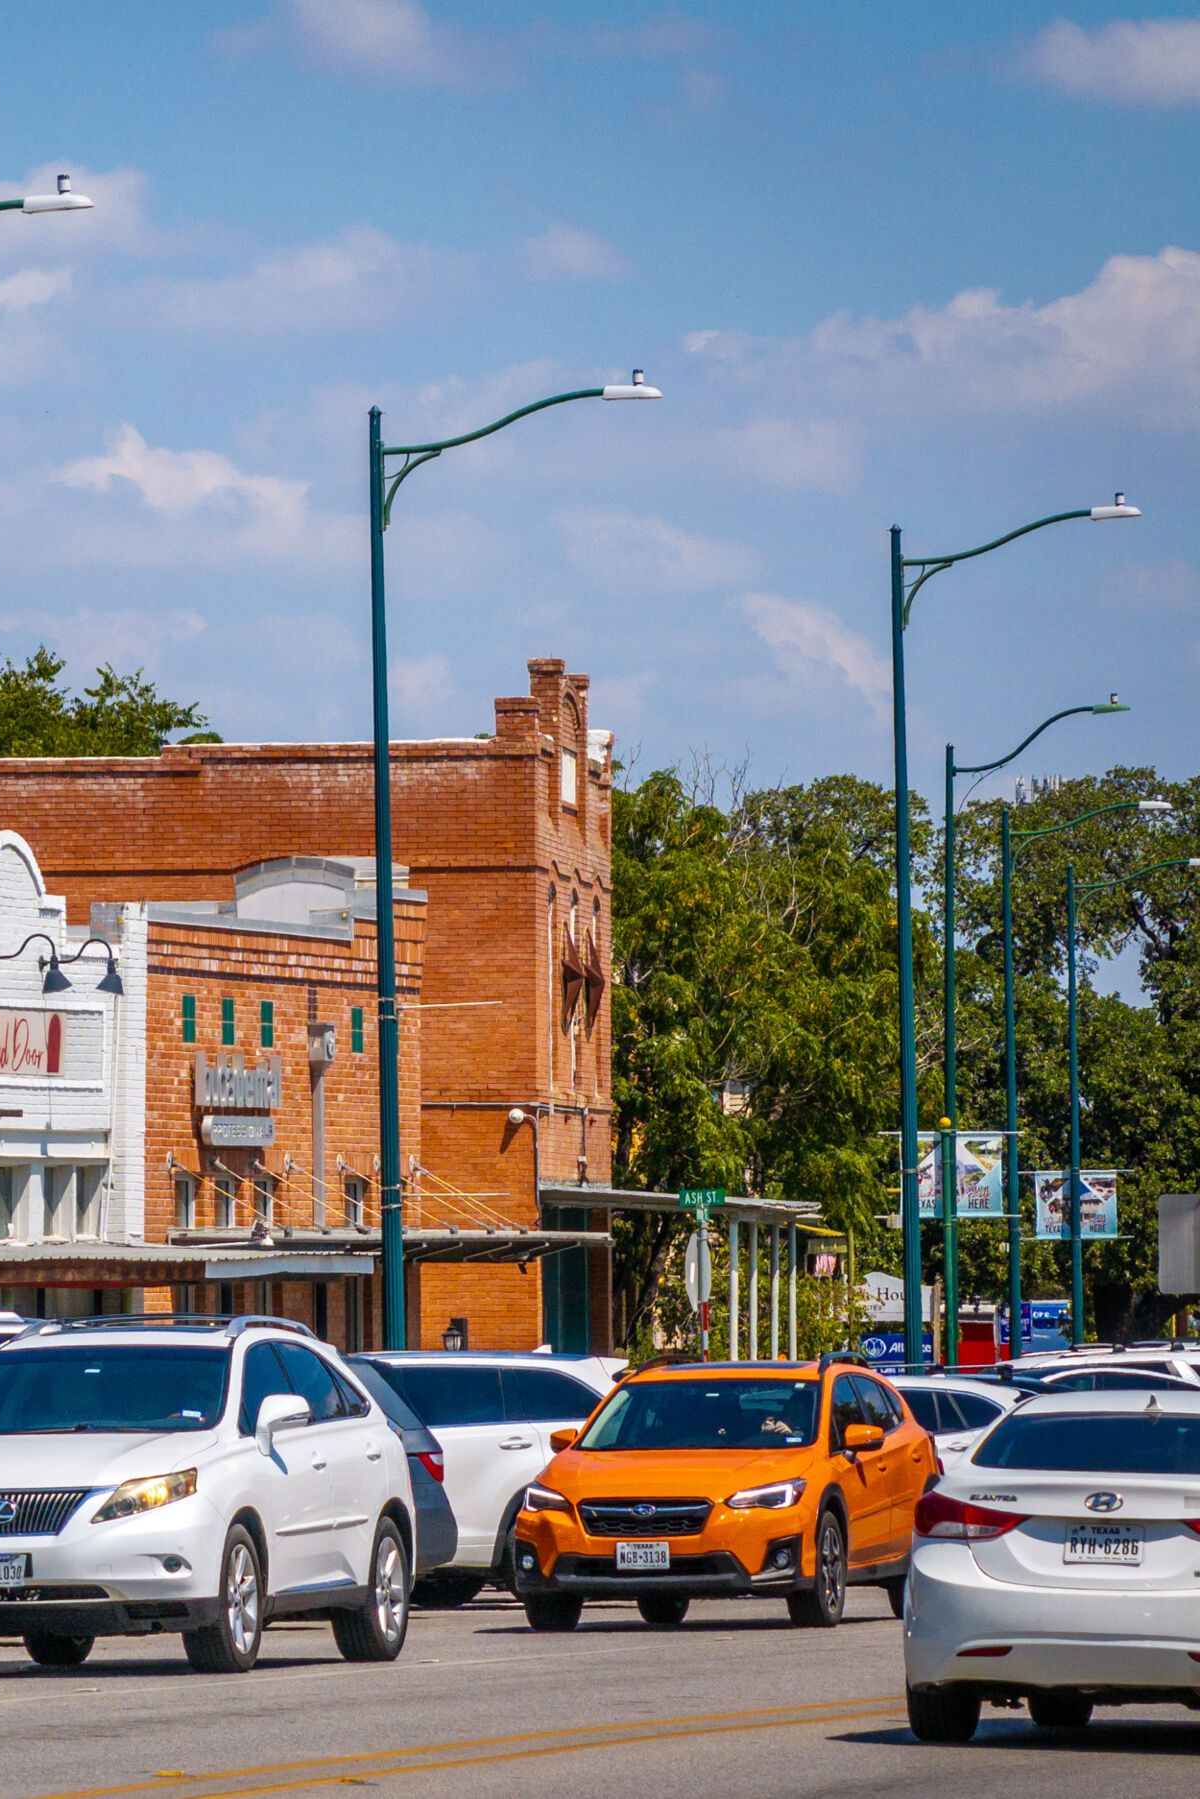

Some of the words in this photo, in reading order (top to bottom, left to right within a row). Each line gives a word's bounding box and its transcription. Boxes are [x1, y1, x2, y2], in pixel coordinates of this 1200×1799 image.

[11, 1018, 44, 1072] Door
[684, 1191, 703, 1204] ASH
[1091, 1526, 1120, 1535] TEXAS
